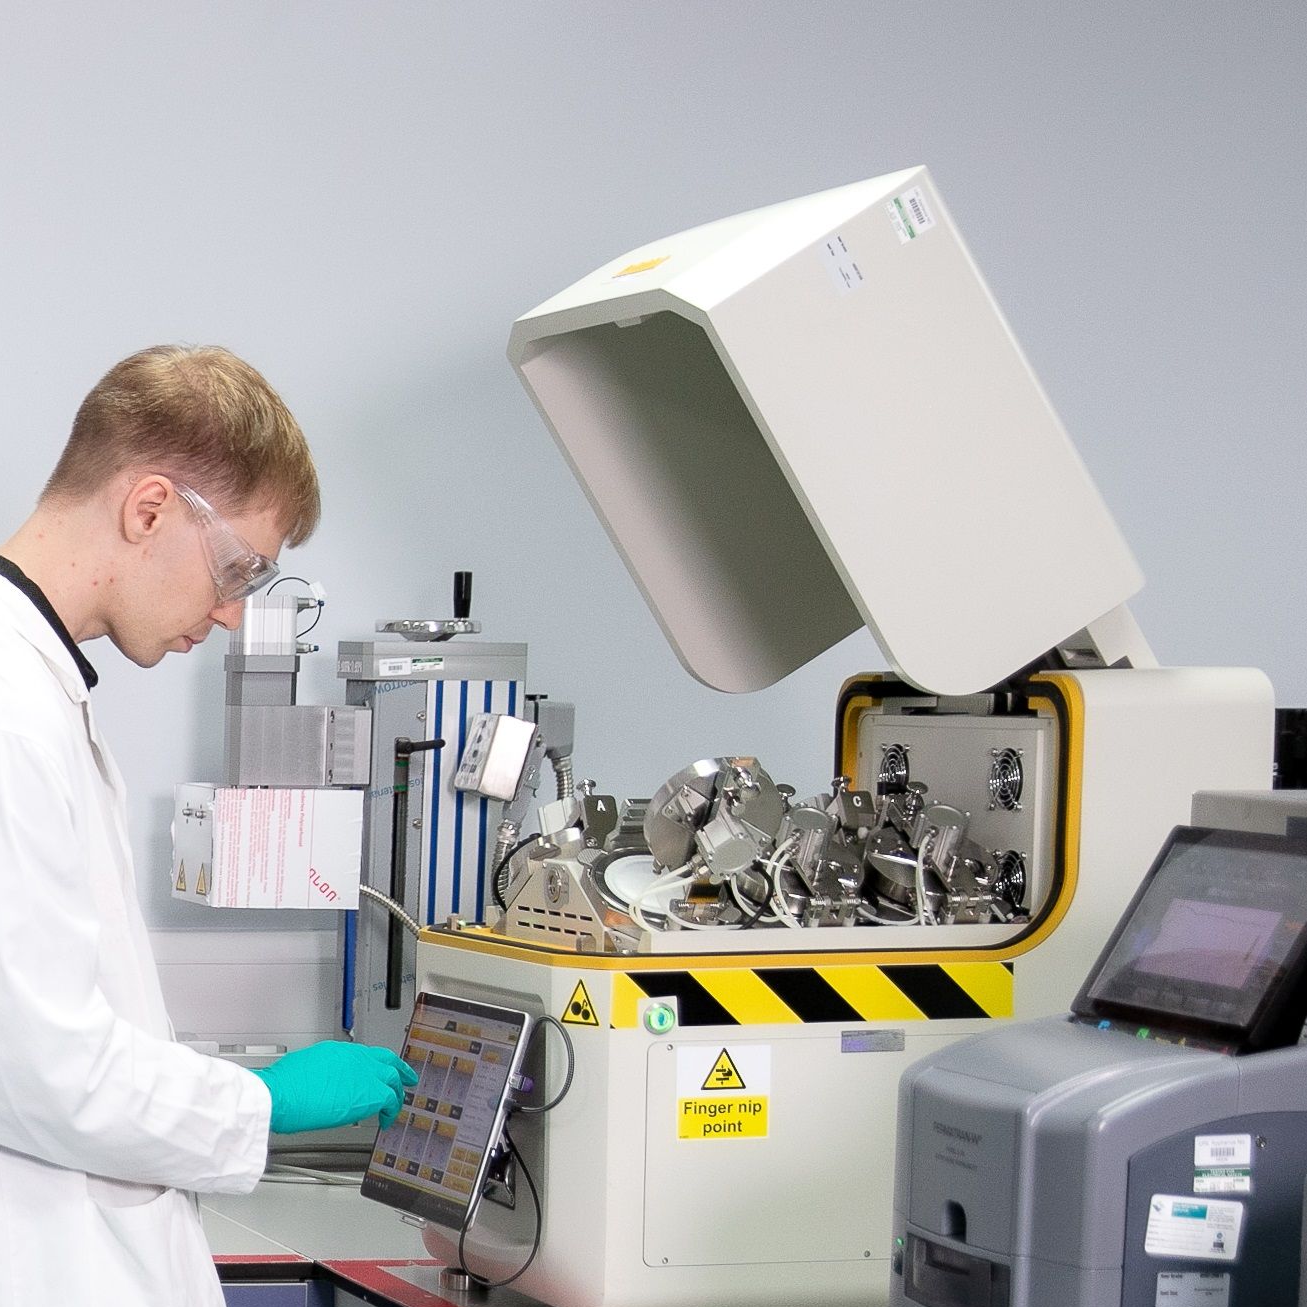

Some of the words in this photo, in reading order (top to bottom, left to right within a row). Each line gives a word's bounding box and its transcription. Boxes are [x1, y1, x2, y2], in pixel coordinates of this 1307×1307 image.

[596, 799, 606, 811] A
[852, 795, 862, 807] C
[683, 1101, 733, 1118] Finger
[738, 1099, 762, 1116] nip
[703, 1120, 742, 1136] point
